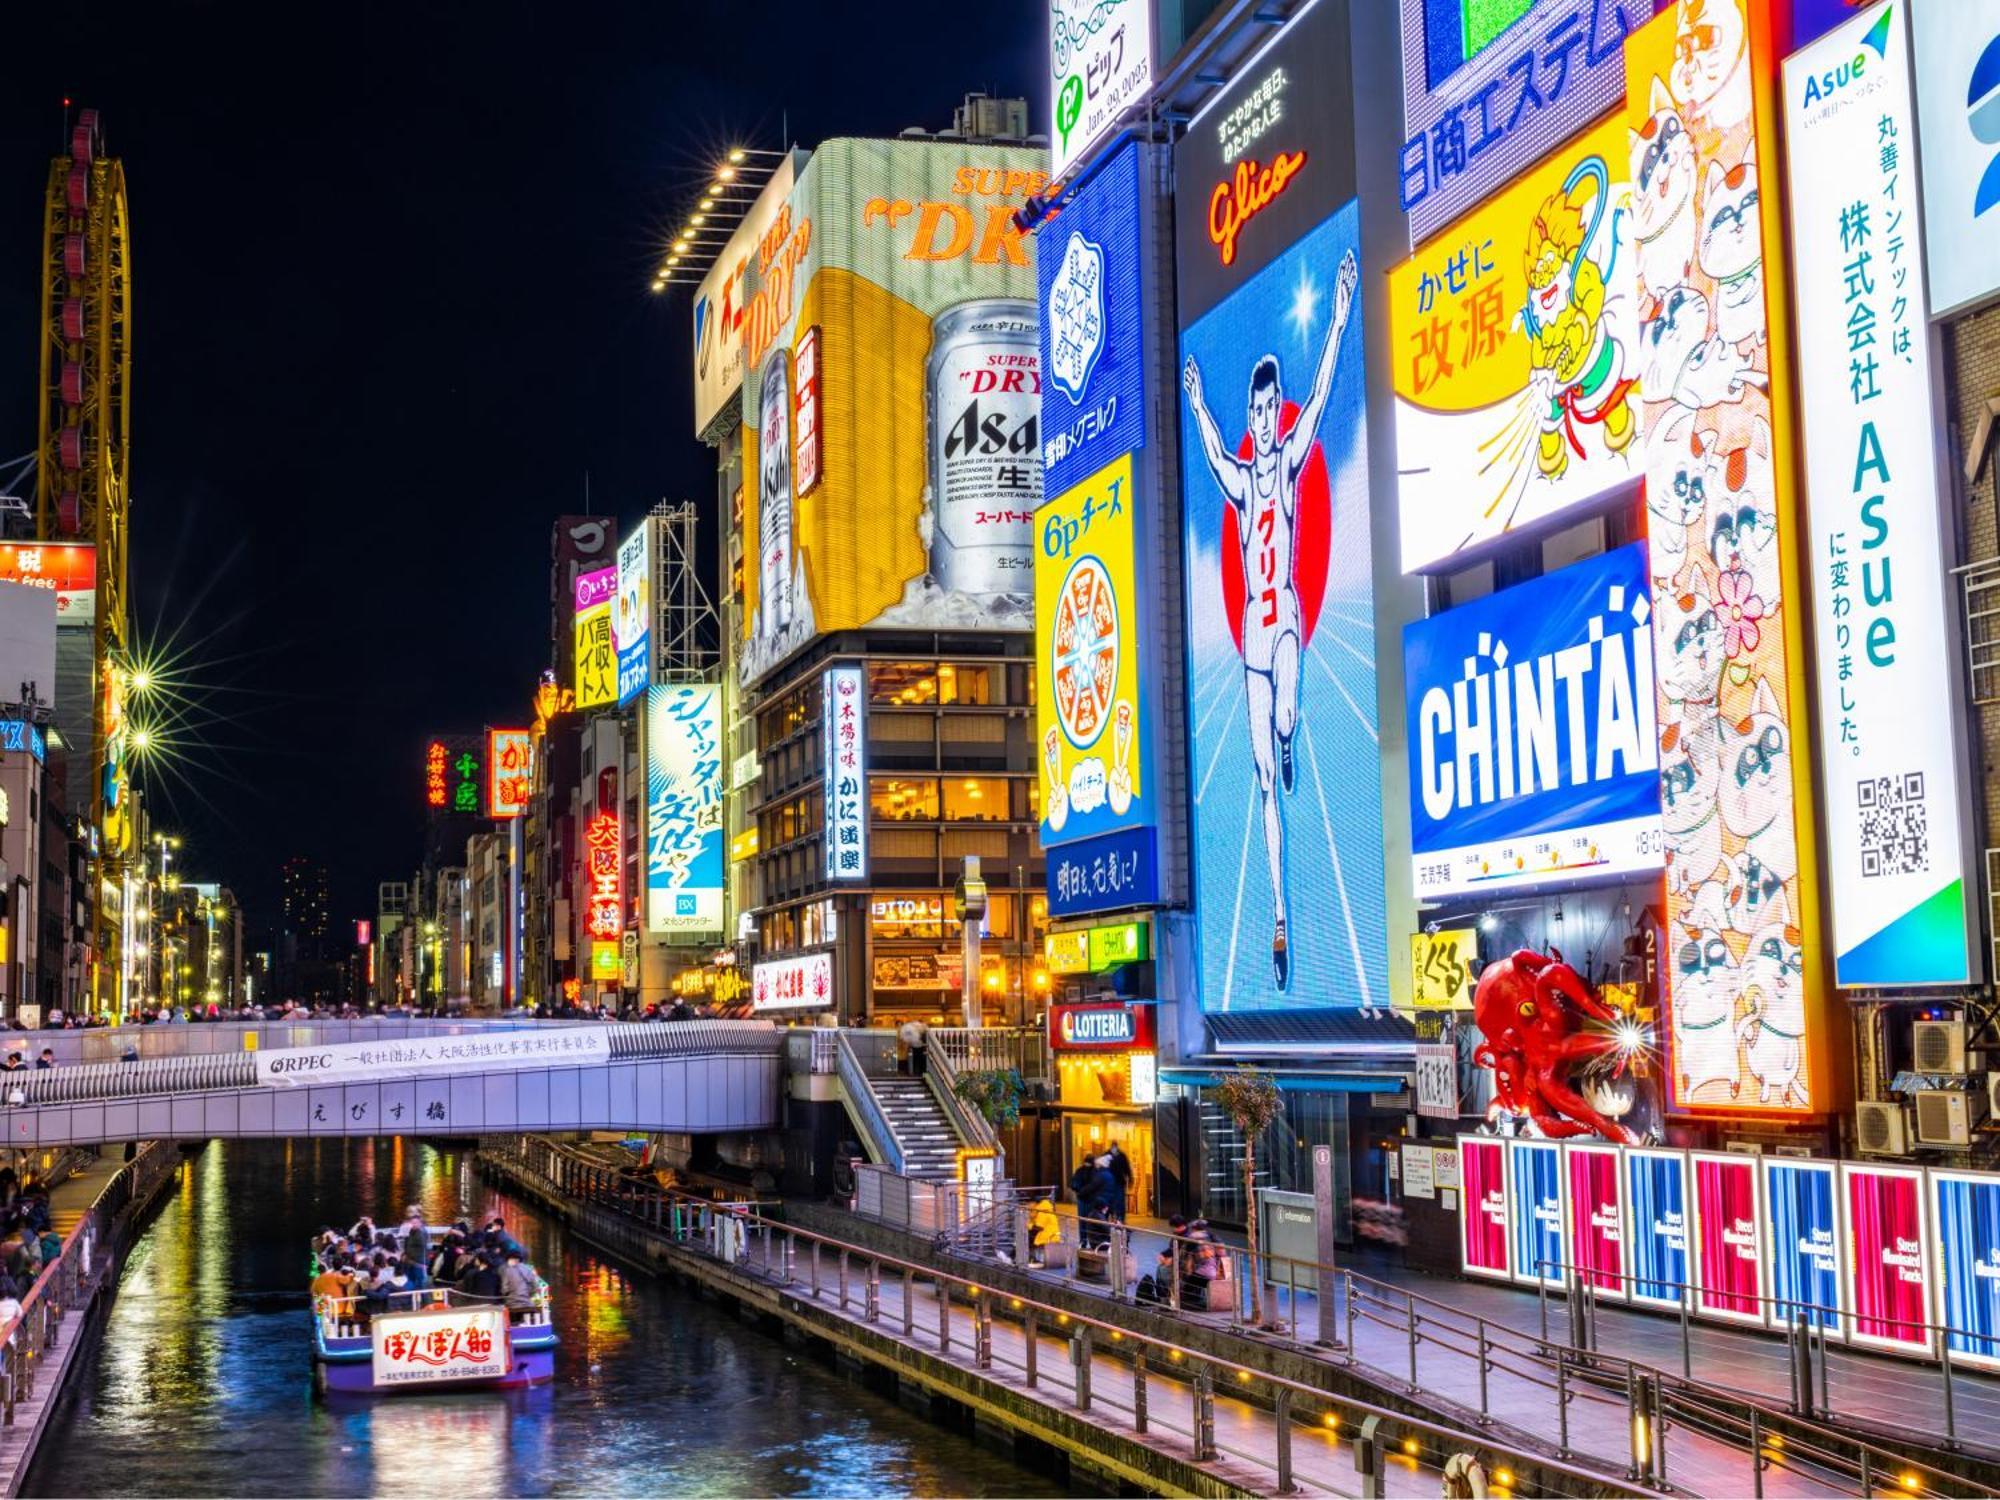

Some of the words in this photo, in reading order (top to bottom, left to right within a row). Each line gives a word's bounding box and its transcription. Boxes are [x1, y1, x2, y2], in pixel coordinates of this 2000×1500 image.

[1086, 24, 1126, 101] ピップ
[1803, 52, 1866, 109] Asue
[1218, 67, 1289, 143] すこやかな毎日、
[1224, 100, 1281, 164] ゆたかな人生
[1400, 0, 1627, 212] 日商エステム
[1209, 151, 1306, 265] Glico
[1877, 113, 1912, 363] 丸善インテックは、
[1417, 239, 1495, 314] かぜに
[1839, 200, 1882, 404] 株式会社
[987, 355, 1037, 367] SUPER
[1410, 277, 1506, 395] 改源
[1044, 396, 1116, 470] 雪印メグミルク
[997, 465, 1032, 490] 生
[1257, 499, 1278, 628] グリコ
[1853, 421, 1896, 668] Asue
[579, 619, 595, 702] バイト
[595, 615, 611, 699] 高収入
[1830, 532, 1860, 756] に変わりました。
[839, 702, 857, 769] 本場の味
[1419, 620, 1658, 820] CHINTAI
[838, 775, 861, 871] かに道楽
[1075, 1013, 1129, 1038] LOTTERIA
[313, 1102, 446, 1122] えびす橋
[384, 1326, 492, 1363] ぽんぽん船
